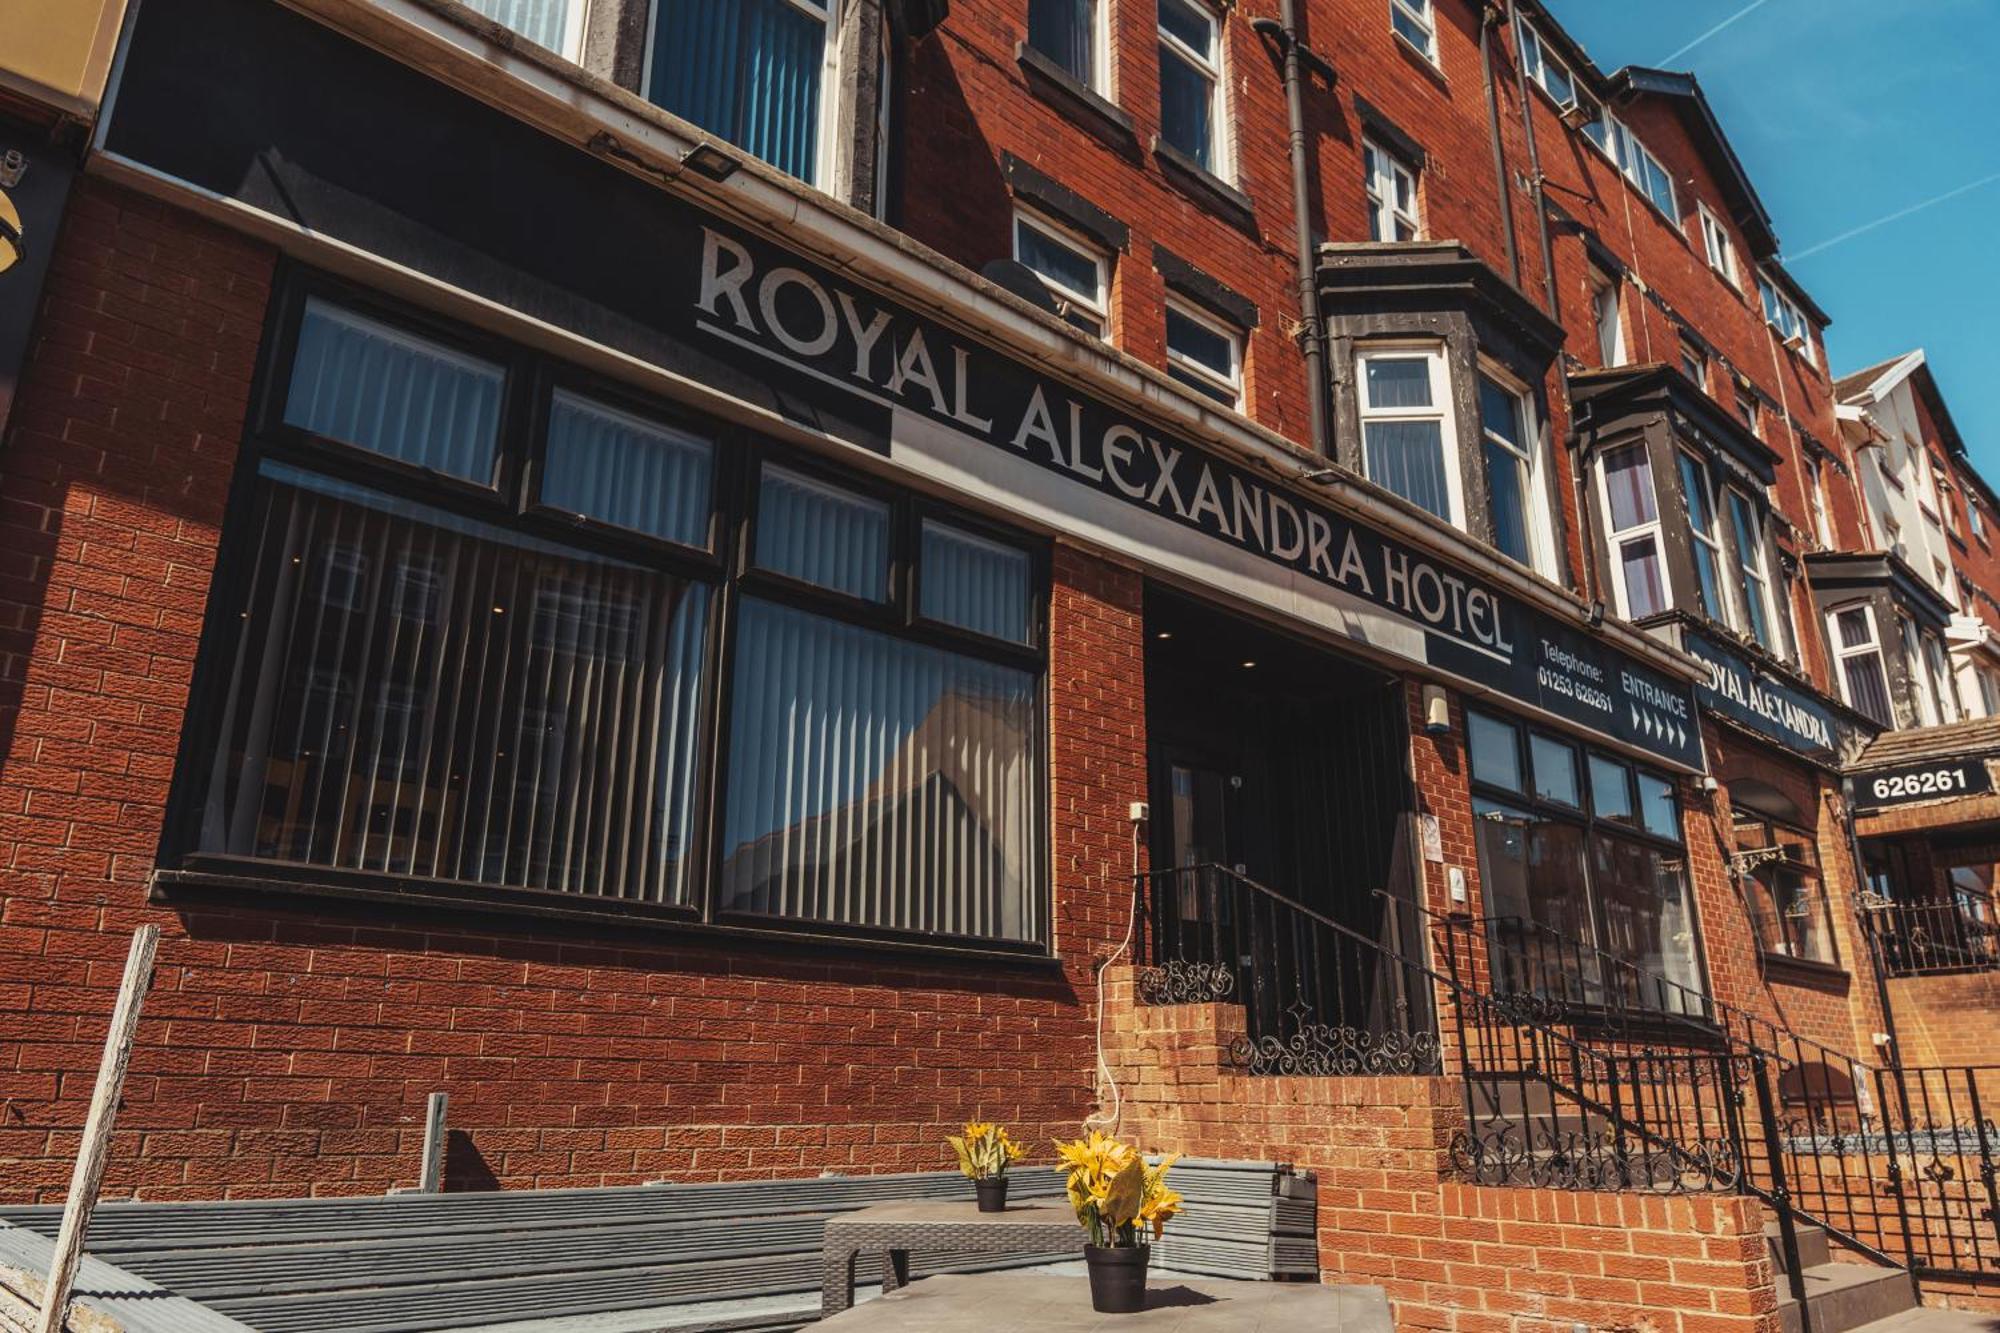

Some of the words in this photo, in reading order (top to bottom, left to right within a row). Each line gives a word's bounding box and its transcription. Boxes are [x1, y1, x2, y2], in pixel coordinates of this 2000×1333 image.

[693, 226, 992, 434] ROYAL
[1010, 384, 1373, 595] ALEXANDRA
[1381, 545, 1513, 653] HOTEL
[1541, 639, 1604, 684] Telephone:
[1539, 666, 1573, 697] 01253
[1575, 681, 1613, 714] 626261
[1621, 671, 1688, 719] ENTRANCE
[1750, 681, 1834, 751] ALEXANDRA
[1873, 769, 1966, 798] 626261
